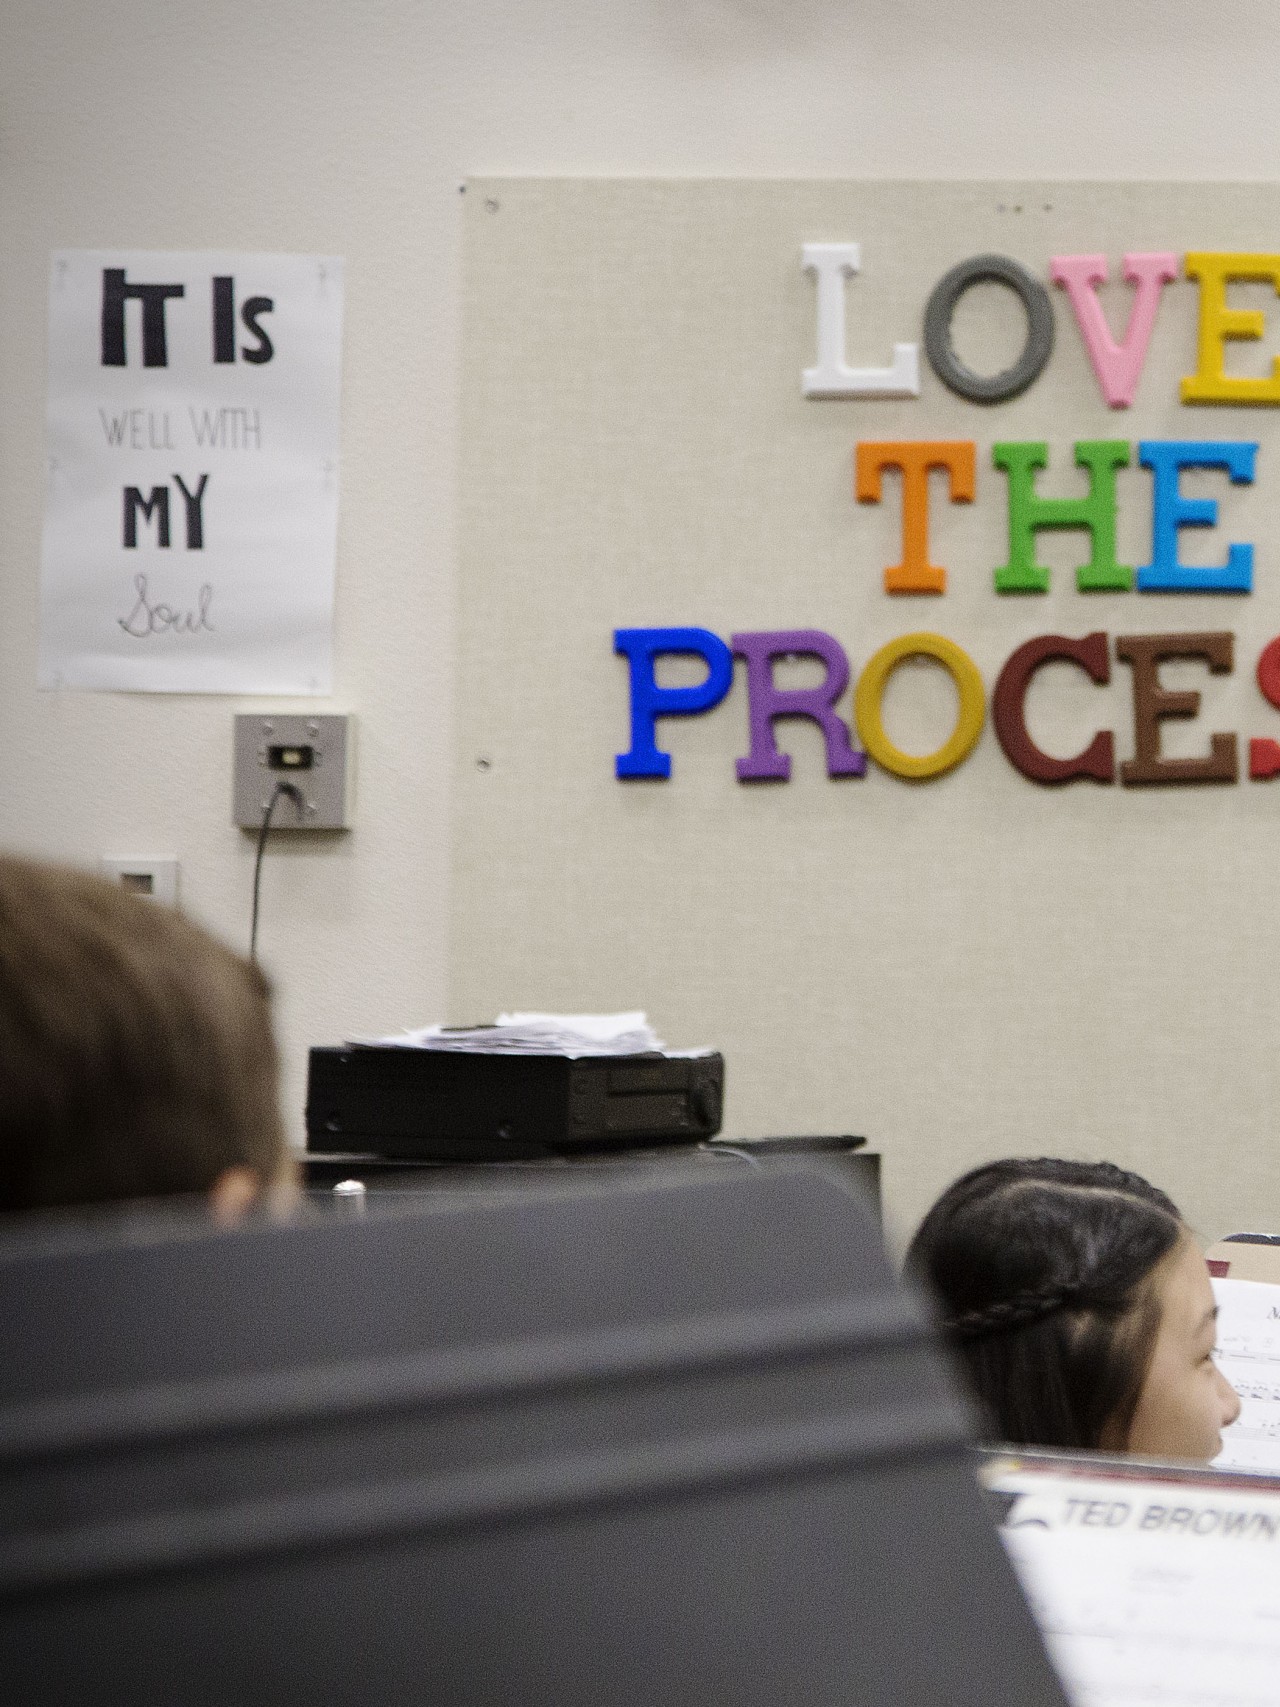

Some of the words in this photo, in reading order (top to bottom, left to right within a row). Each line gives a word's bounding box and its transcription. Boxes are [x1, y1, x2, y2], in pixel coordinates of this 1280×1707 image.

[101, 267, 185, 368] IT
[211, 275, 274, 365] Is
[98, 406, 175, 450] WELL
[188, 406, 262, 450] WITH
[122, 472, 210, 550] MY
[855, 440, 1260, 594] THE
[117, 572, 216, 639] Soul
[1061, 1497, 1132, 1528] TED
